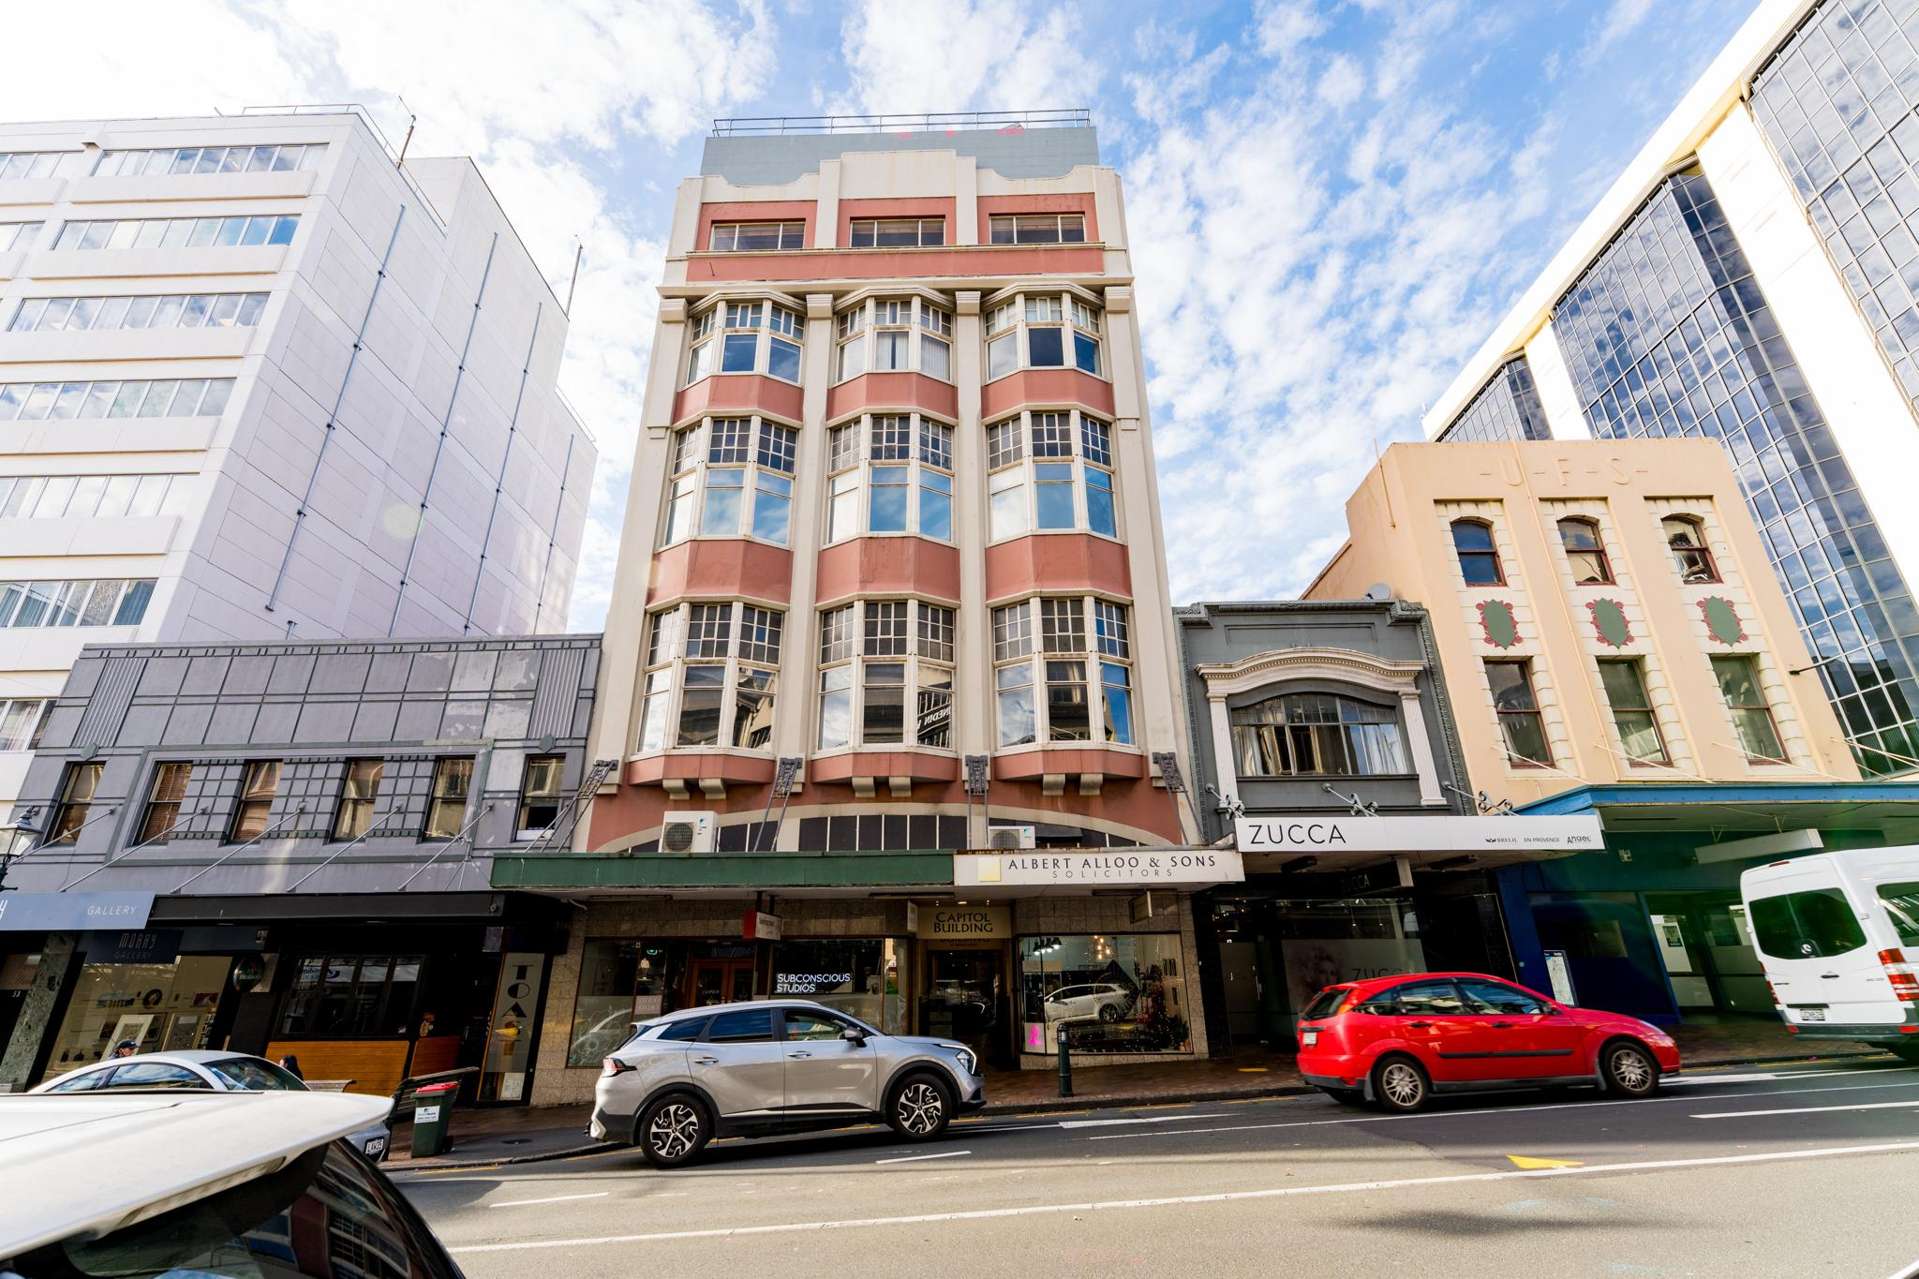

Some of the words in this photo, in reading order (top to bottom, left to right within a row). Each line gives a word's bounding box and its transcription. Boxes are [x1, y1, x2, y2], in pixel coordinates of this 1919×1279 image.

[1248, 824, 1347, 845] ZUCCA
[1008, 857, 1071, 870] ALBERT
[1082, 856, 1140, 869] ALLOO
[1149, 856, 1160, 868] &
[1170, 855, 1217, 867] SONS
[1052, 868, 1173, 880] SOLICITORS
[87, 905, 137, 916] GALLERY
[935, 911, 991, 923] CAPITOL
[934, 923, 993, 933] BUILDING
[776, 972, 851, 984] SUBCONSCIOUS
[776, 983, 816, 993] STUDIOS
